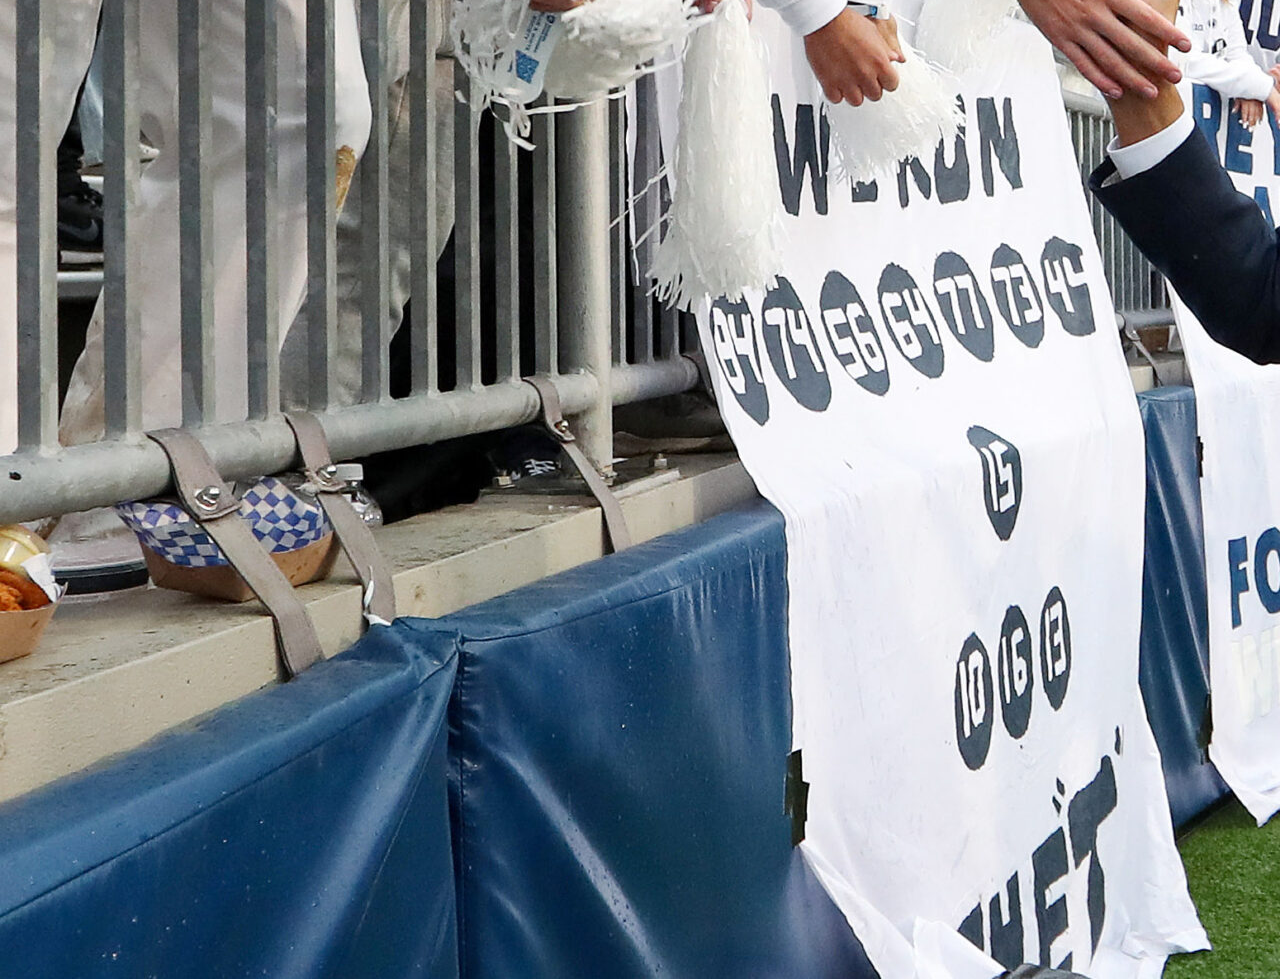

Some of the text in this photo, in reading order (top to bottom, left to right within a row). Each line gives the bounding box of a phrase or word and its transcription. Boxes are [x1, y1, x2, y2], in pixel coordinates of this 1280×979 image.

[771, 93, 878, 217] W
[712, 306, 765, 395] 84
[763, 306, 826, 380] 74
[822, 303, 887, 380] 56
[885, 286, 943, 360] 64
[934, 272, 986, 336] 77
[990, 263, 1044, 328] 73
[982, 440, 1017, 512] 15
[958, 600, 1065, 738] 10 16 13
